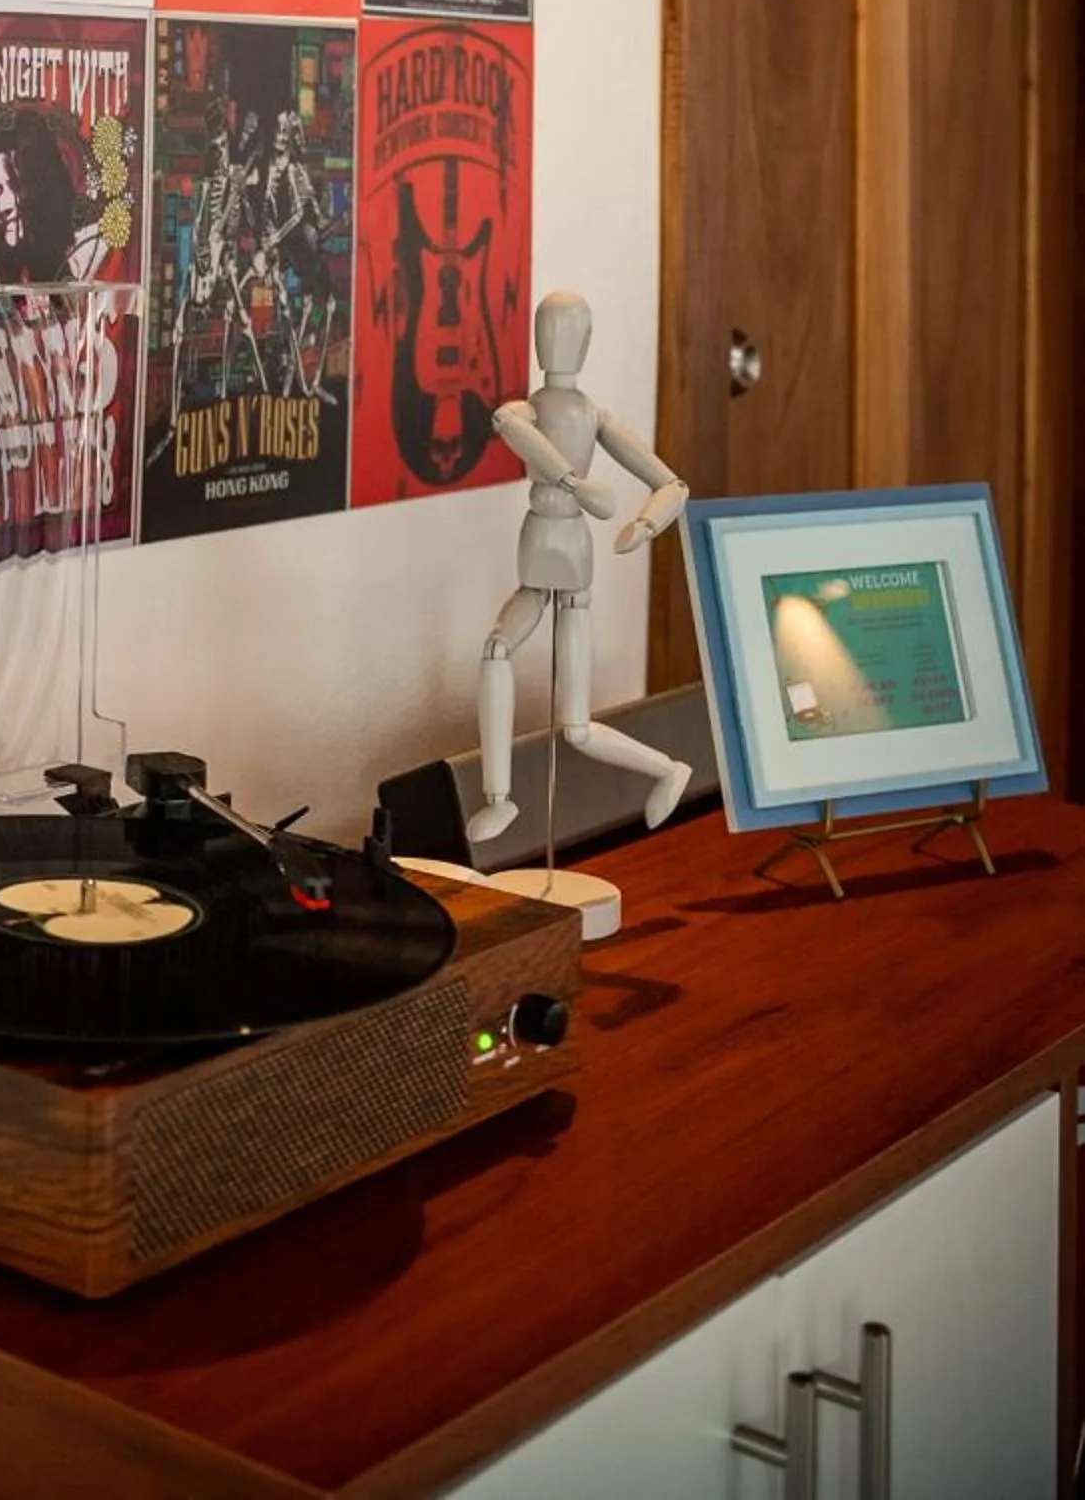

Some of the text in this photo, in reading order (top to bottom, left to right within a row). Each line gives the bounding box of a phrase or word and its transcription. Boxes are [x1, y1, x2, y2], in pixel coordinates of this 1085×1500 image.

[68, 49, 129, 127] WITH
[376, 46, 446, 138] HARD
[175, 398, 232, 478] GUNS
[258, 393, 321, 461] ROSES
[205, 470, 290, 501] HONG KONG
[850, 570, 919, 590] WELCOME
